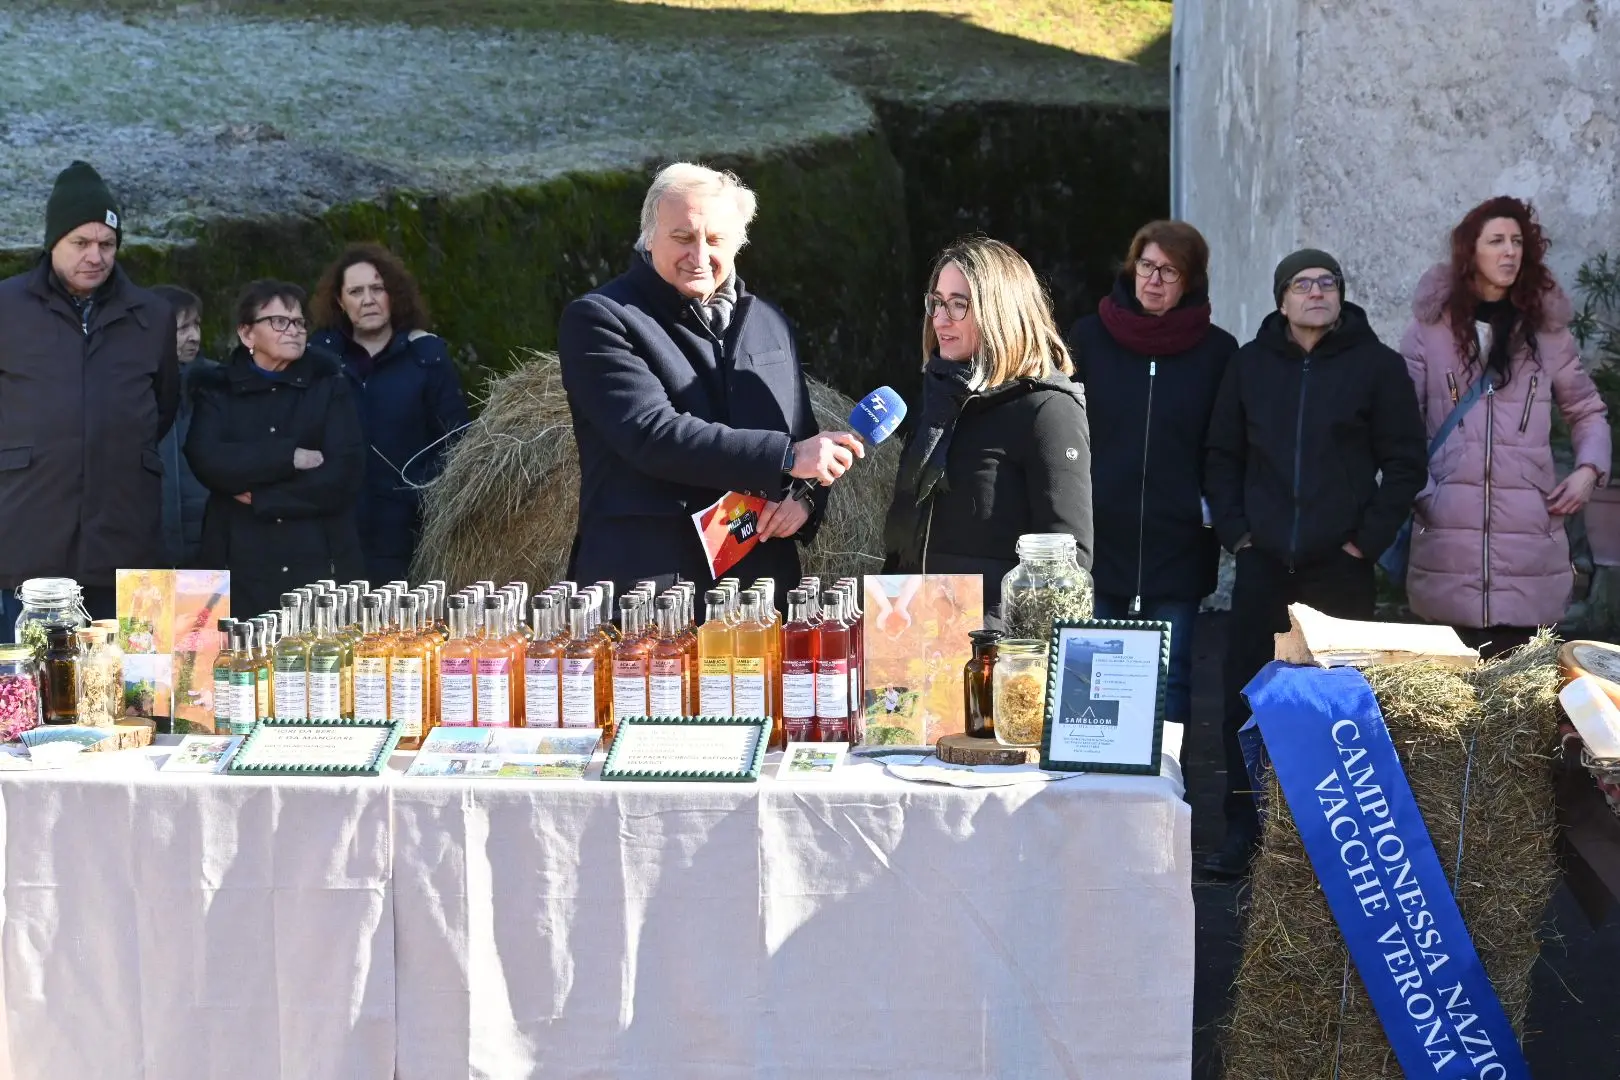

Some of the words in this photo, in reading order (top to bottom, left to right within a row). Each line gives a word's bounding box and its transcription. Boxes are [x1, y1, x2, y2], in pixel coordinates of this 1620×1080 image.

[741, 522, 754, 539] NOI
[1064, 717, 1113, 725] SAMBLOOM
[1332, 720, 1449, 976] CAMPIONESSA
[1315, 769, 1391, 916] VACCHE
[1377, 922, 1457, 1073] VERONA
